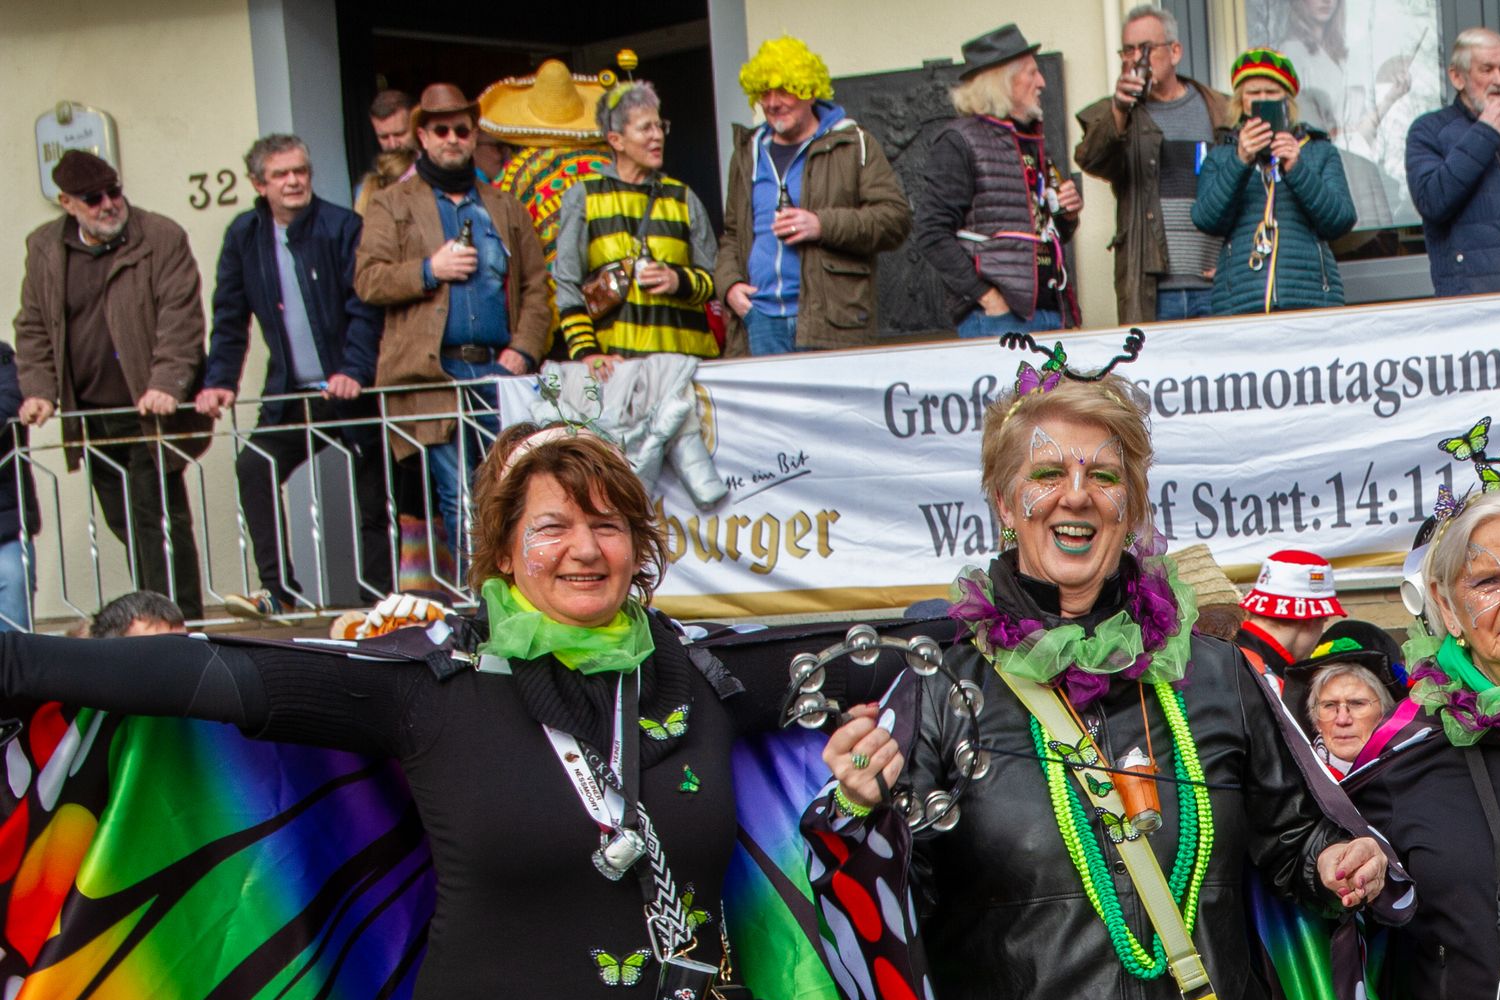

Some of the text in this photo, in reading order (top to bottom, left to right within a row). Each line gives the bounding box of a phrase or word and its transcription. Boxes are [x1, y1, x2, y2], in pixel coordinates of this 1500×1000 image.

[188, 169, 238, 210] 32
[884, 373, 997, 438] Groß
[752, 471, 776, 485] ein
[777, 450, 811, 474] Bit
[655, 495, 841, 575] burger
[1274, 597, 1335, 617] KÖLN
[574, 768, 600, 812] NESSMOORT
